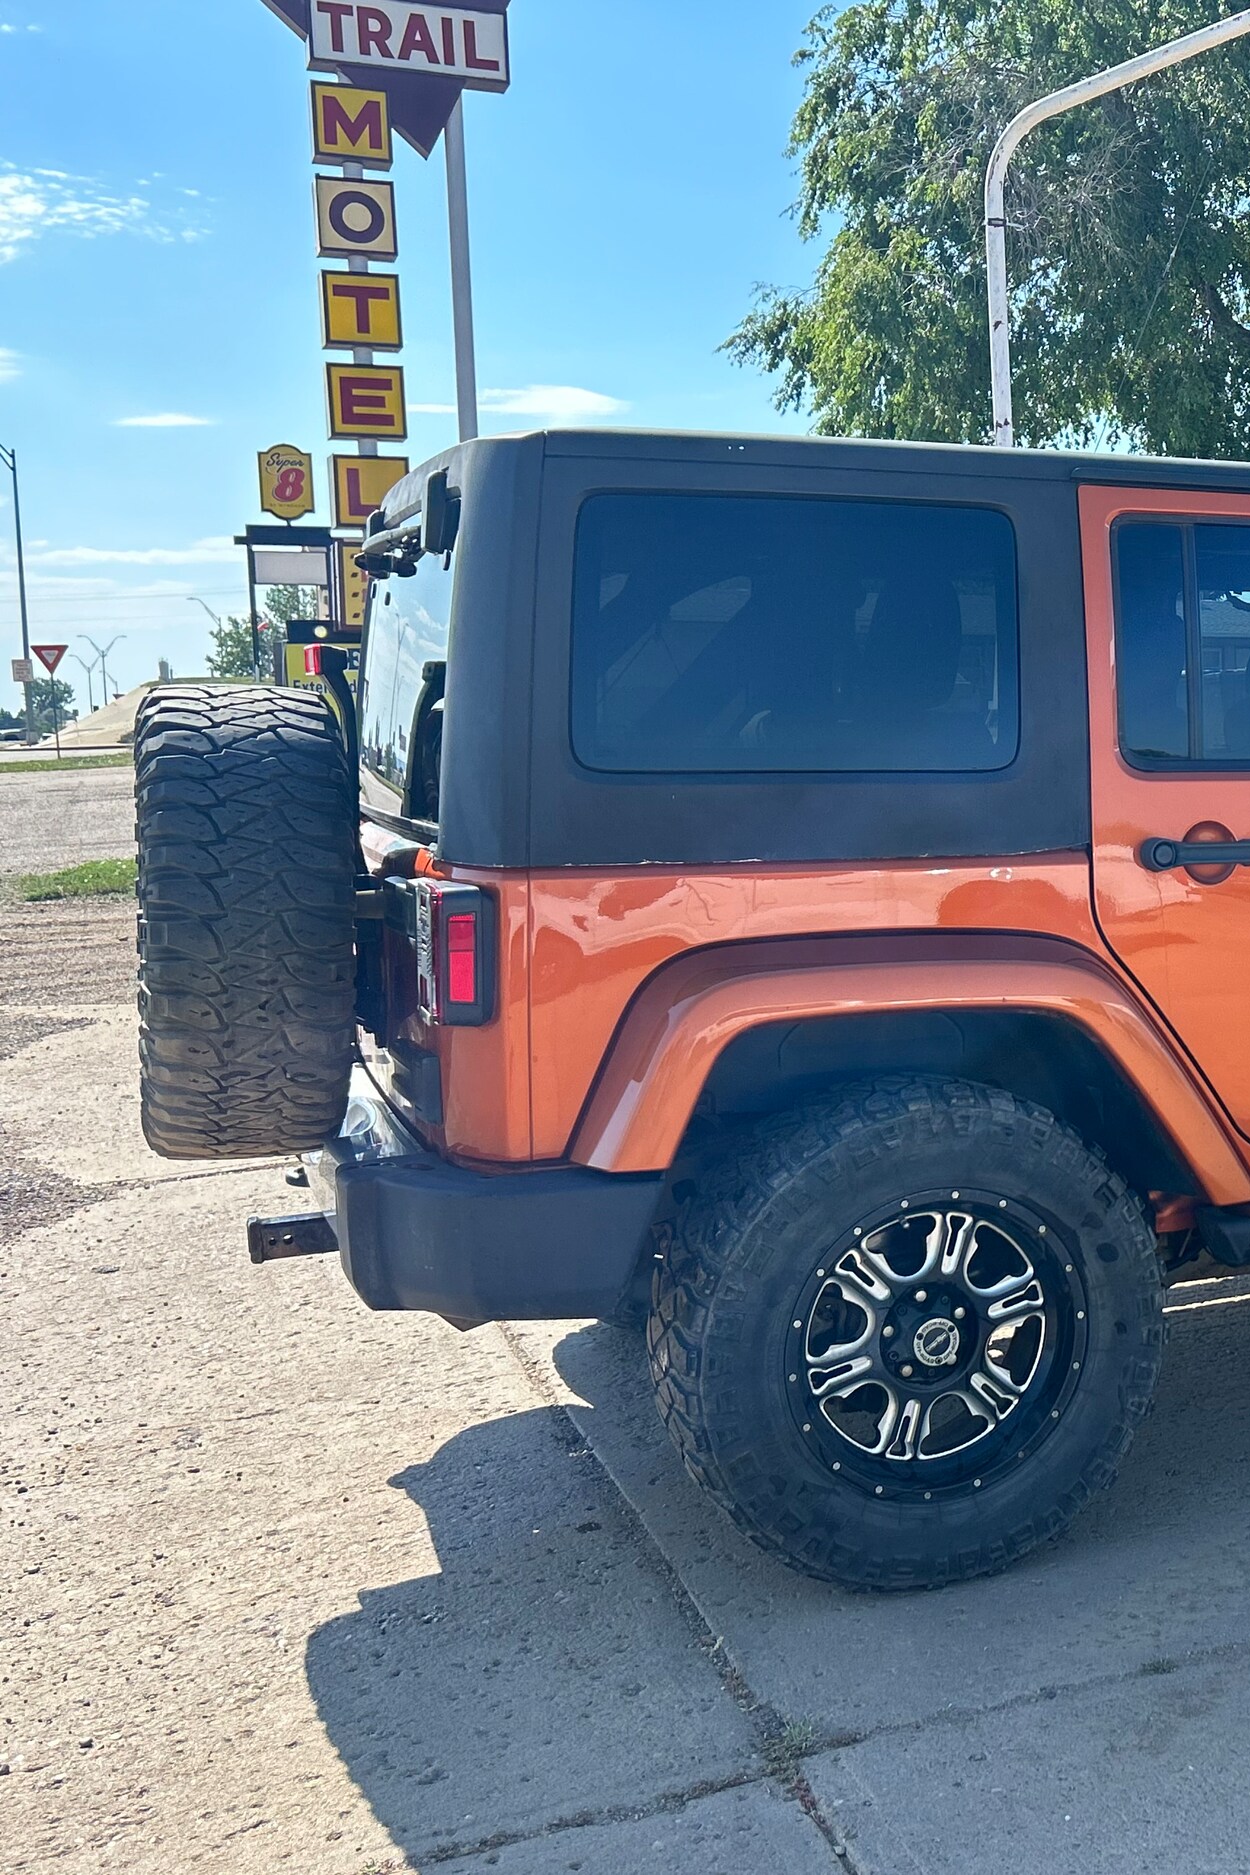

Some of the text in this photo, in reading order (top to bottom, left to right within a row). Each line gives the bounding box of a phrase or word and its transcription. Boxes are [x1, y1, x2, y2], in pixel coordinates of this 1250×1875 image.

[317, 2, 500, 72] TRAIL
[322, 95, 396, 516] MOTEL
[266, 452, 304, 473] Super
[272, 467, 306, 503] 8
